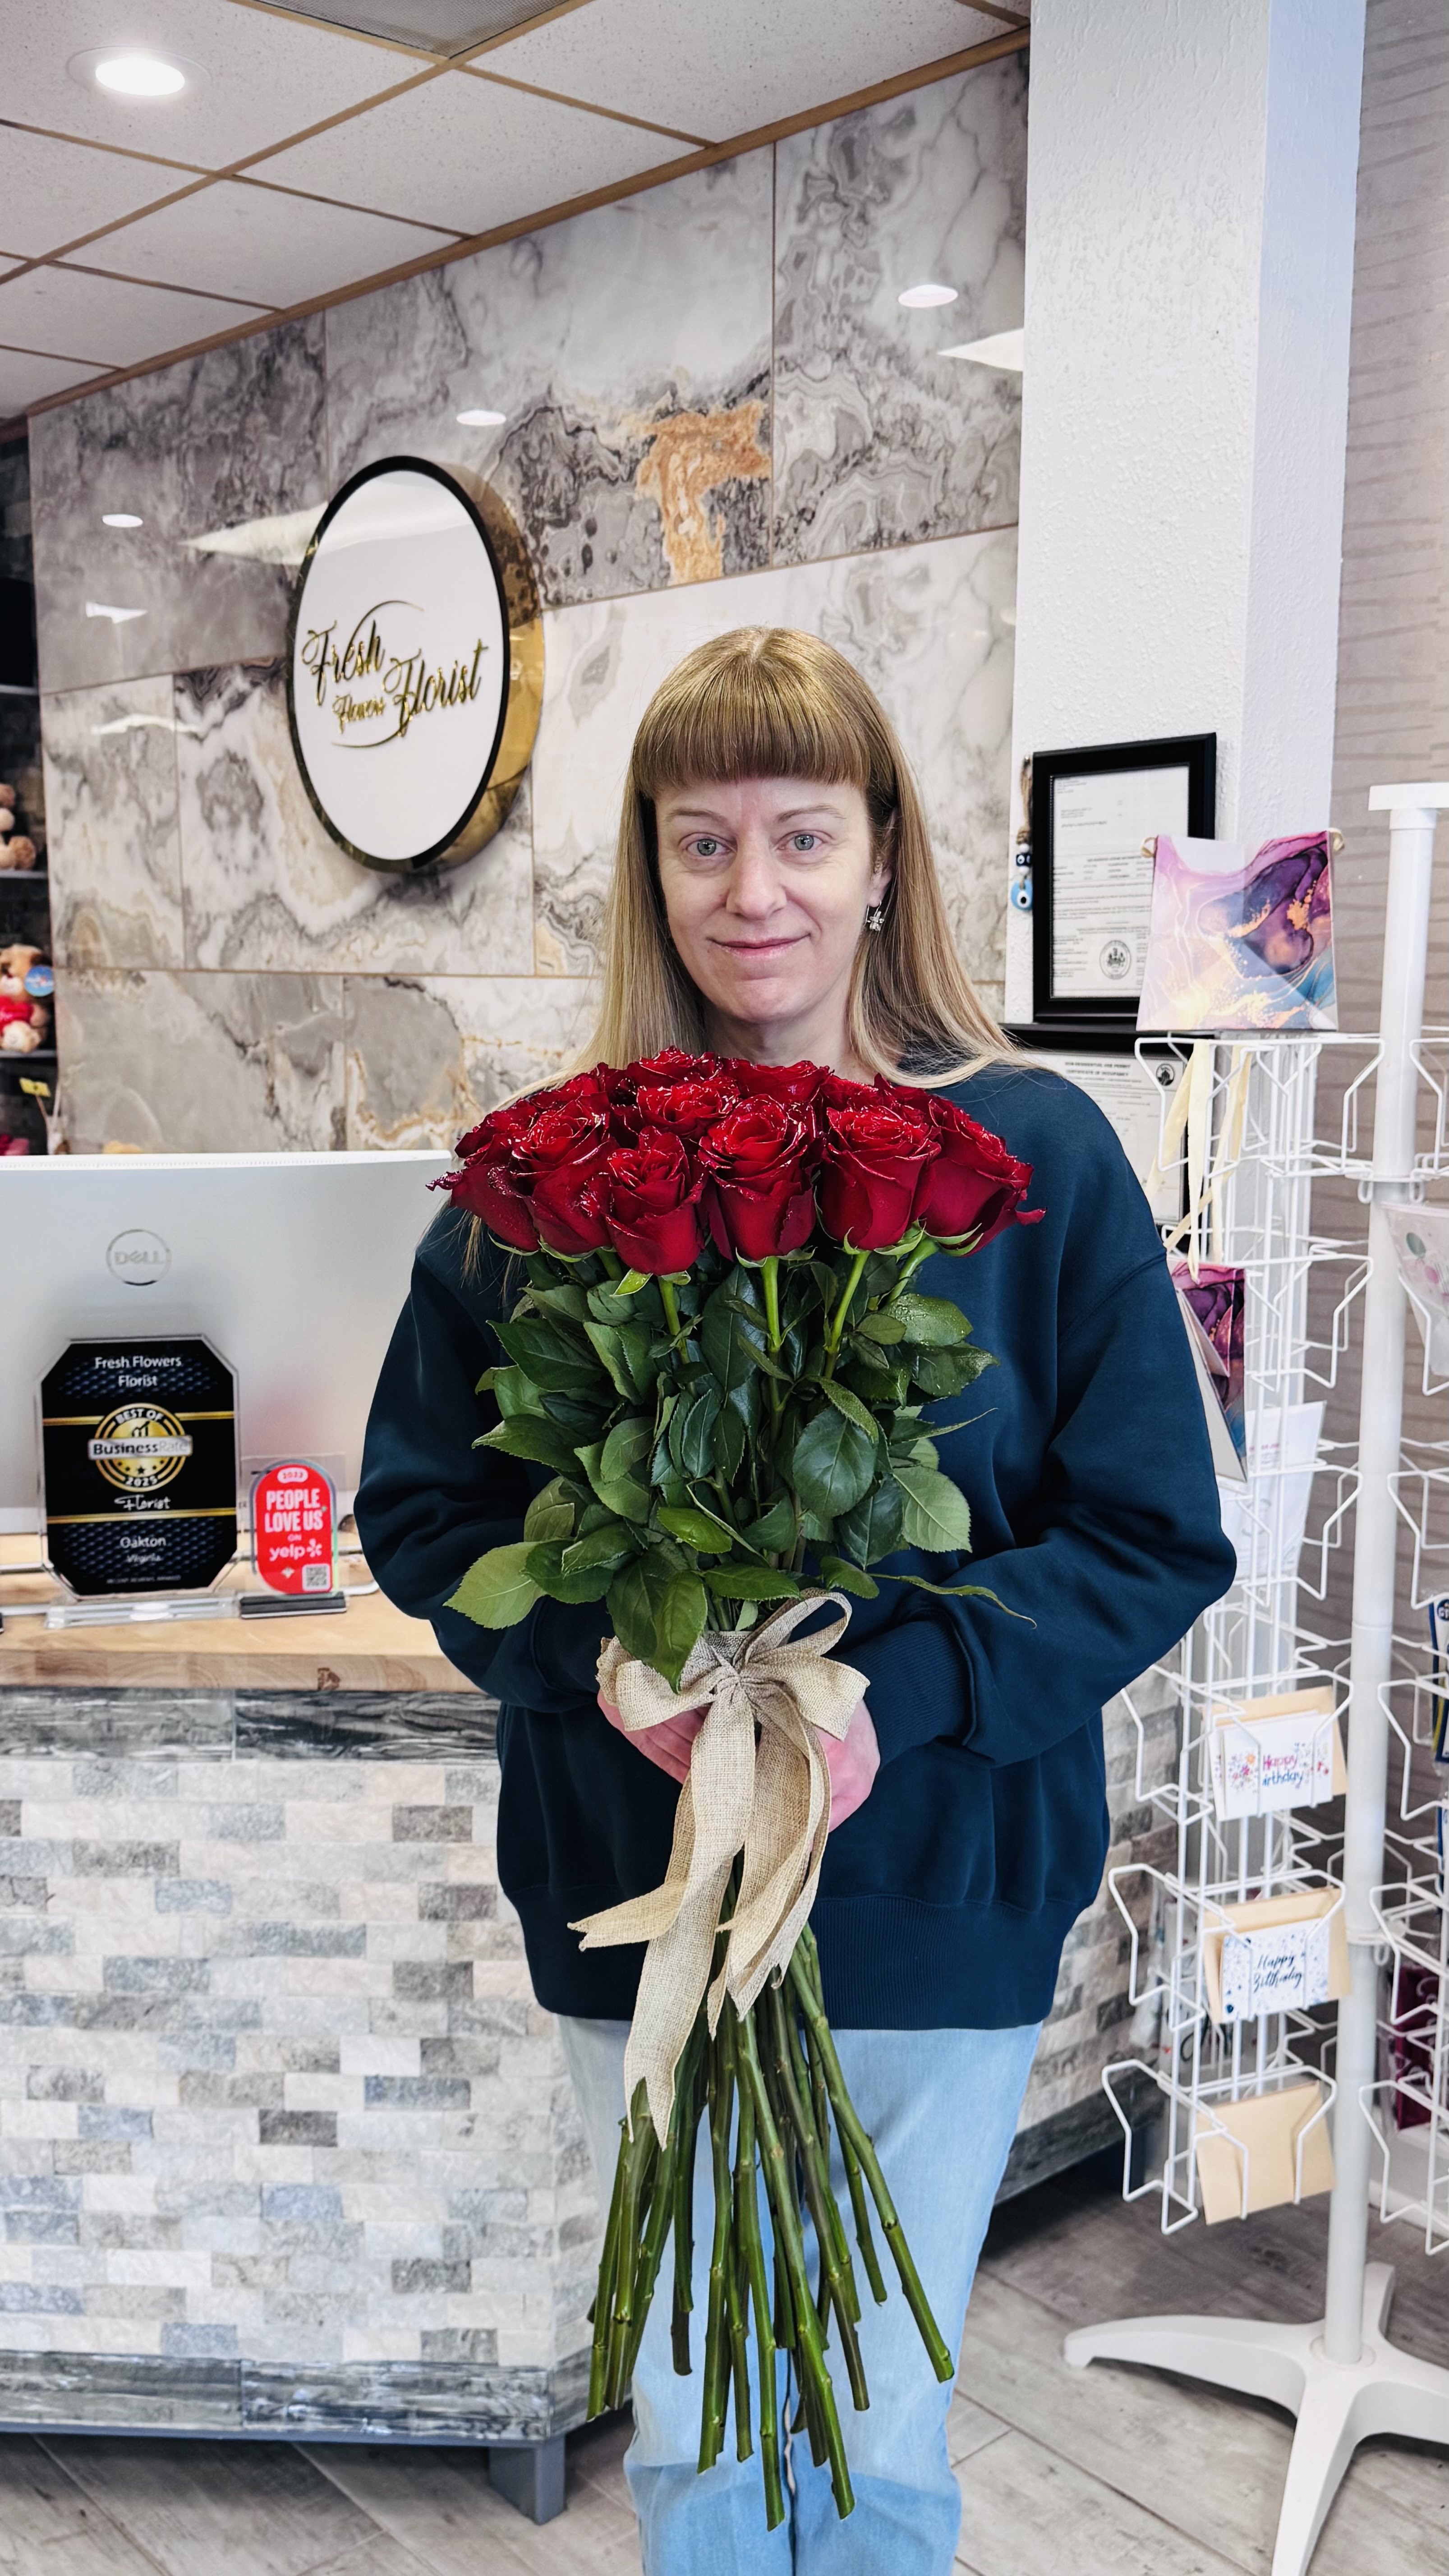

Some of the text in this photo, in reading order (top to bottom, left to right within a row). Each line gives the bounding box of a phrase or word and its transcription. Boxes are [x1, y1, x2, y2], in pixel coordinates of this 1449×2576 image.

[301, 619, 385, 706] Fresh
[382, 638, 488, 737] Florist
[114, 1251, 165, 1265] DELL
[94, 1355, 182, 1370] Fresh Flowers
[118, 1374, 158, 1388] Florist
[115, 1408, 165, 1425] BEST OF
[93, 1440, 188, 1455] BusinessRate
[125, 1475, 158, 1487] 2025
[113, 1494, 171, 1511] Florist
[266, 1488, 321, 1511] PEOPLE
[264, 1509, 324, 1533] LOVE US
[120, 1536, 166, 1549] Oakton
[287, 1534, 302, 1542] ON
[269, 1544, 306, 1562] yelp
[1263, 1754, 1298, 1773] Happy
[1261, 1768, 1304, 1789] irthday
[1257, 1954, 1296, 1970] Happy
